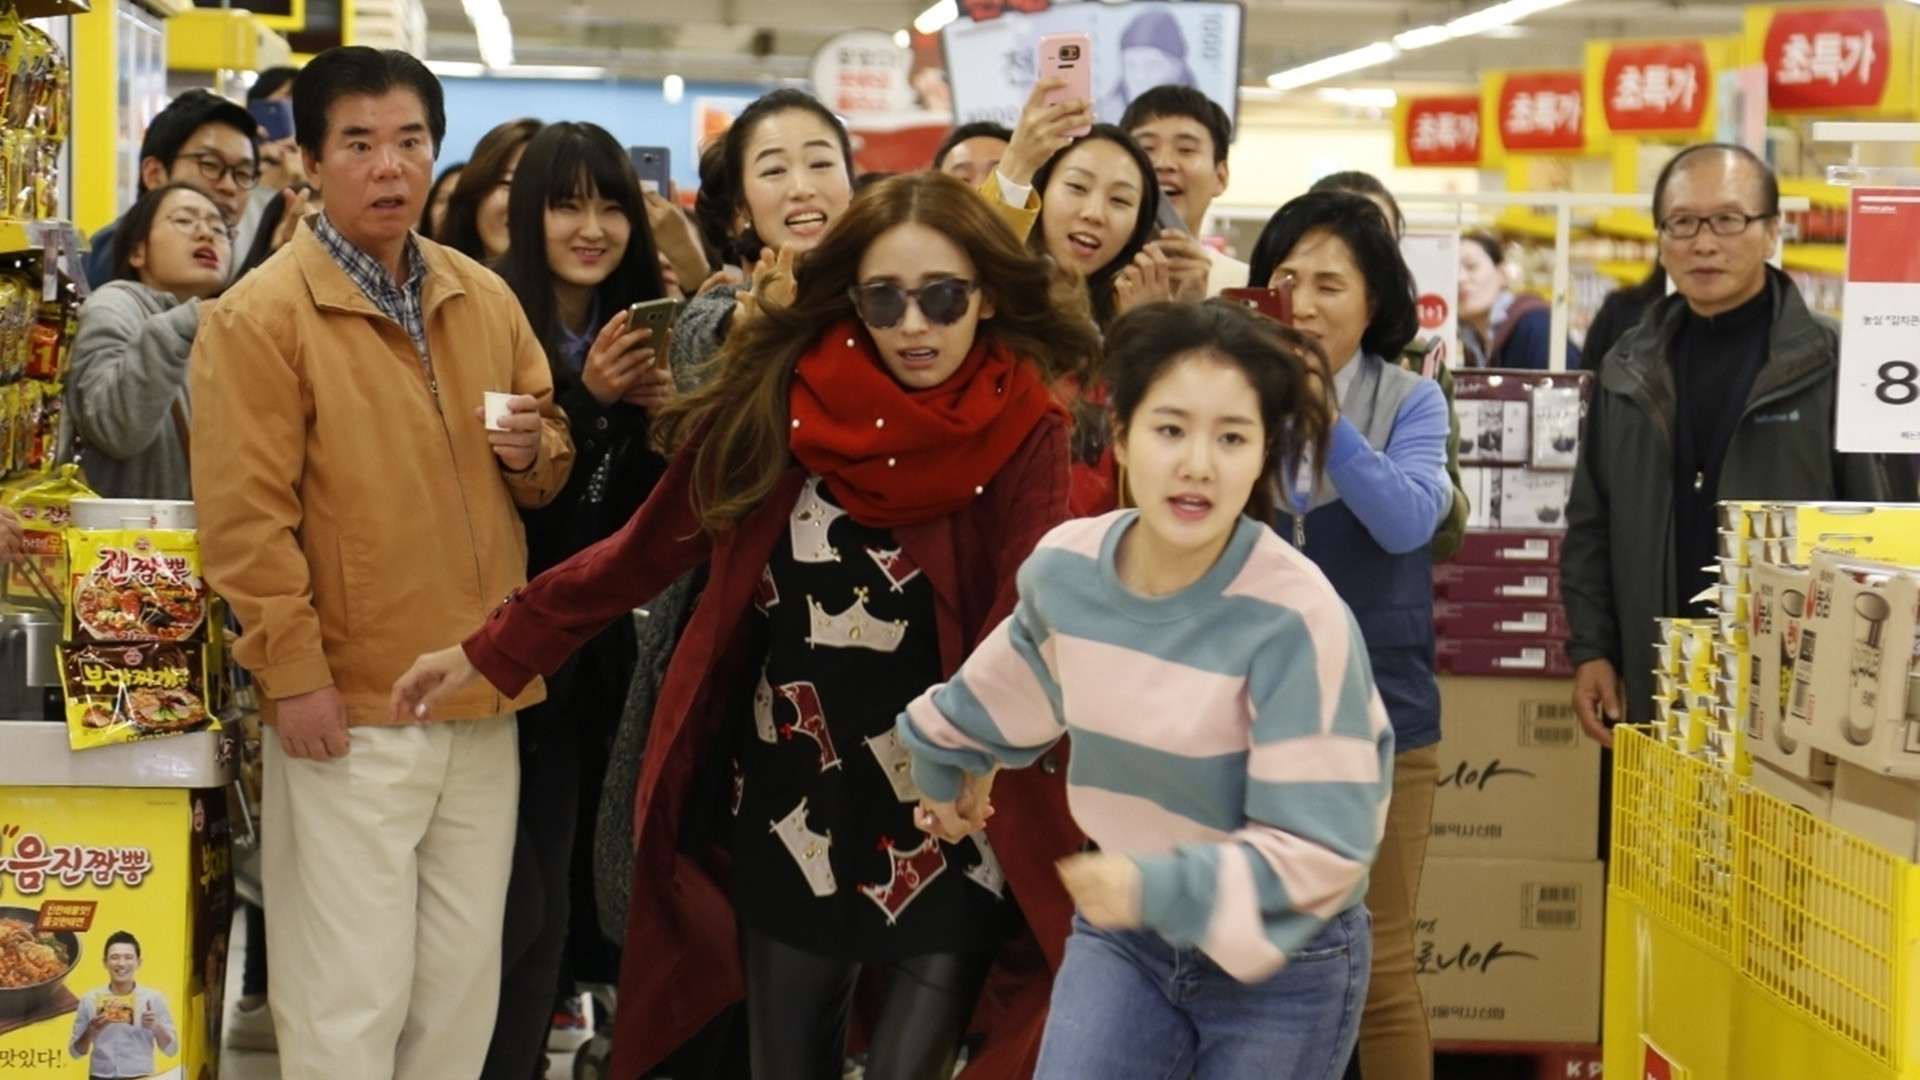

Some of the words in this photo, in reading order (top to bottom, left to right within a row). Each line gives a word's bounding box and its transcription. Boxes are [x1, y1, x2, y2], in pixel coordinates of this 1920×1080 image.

[1778, 30, 1875, 85] 초특가
[1611, 63, 1697, 112] 초특가
[1411, 112, 1479, 151] 초특가
[1505, 91, 1582, 134] 초특가
[1875, 360, 1920, 405] 8
[98, 548, 191, 585] 진짬뽕
[0, 834, 149, 892] 음진짬뽕
[0, 1048, 63, 1069] 맛있다!
